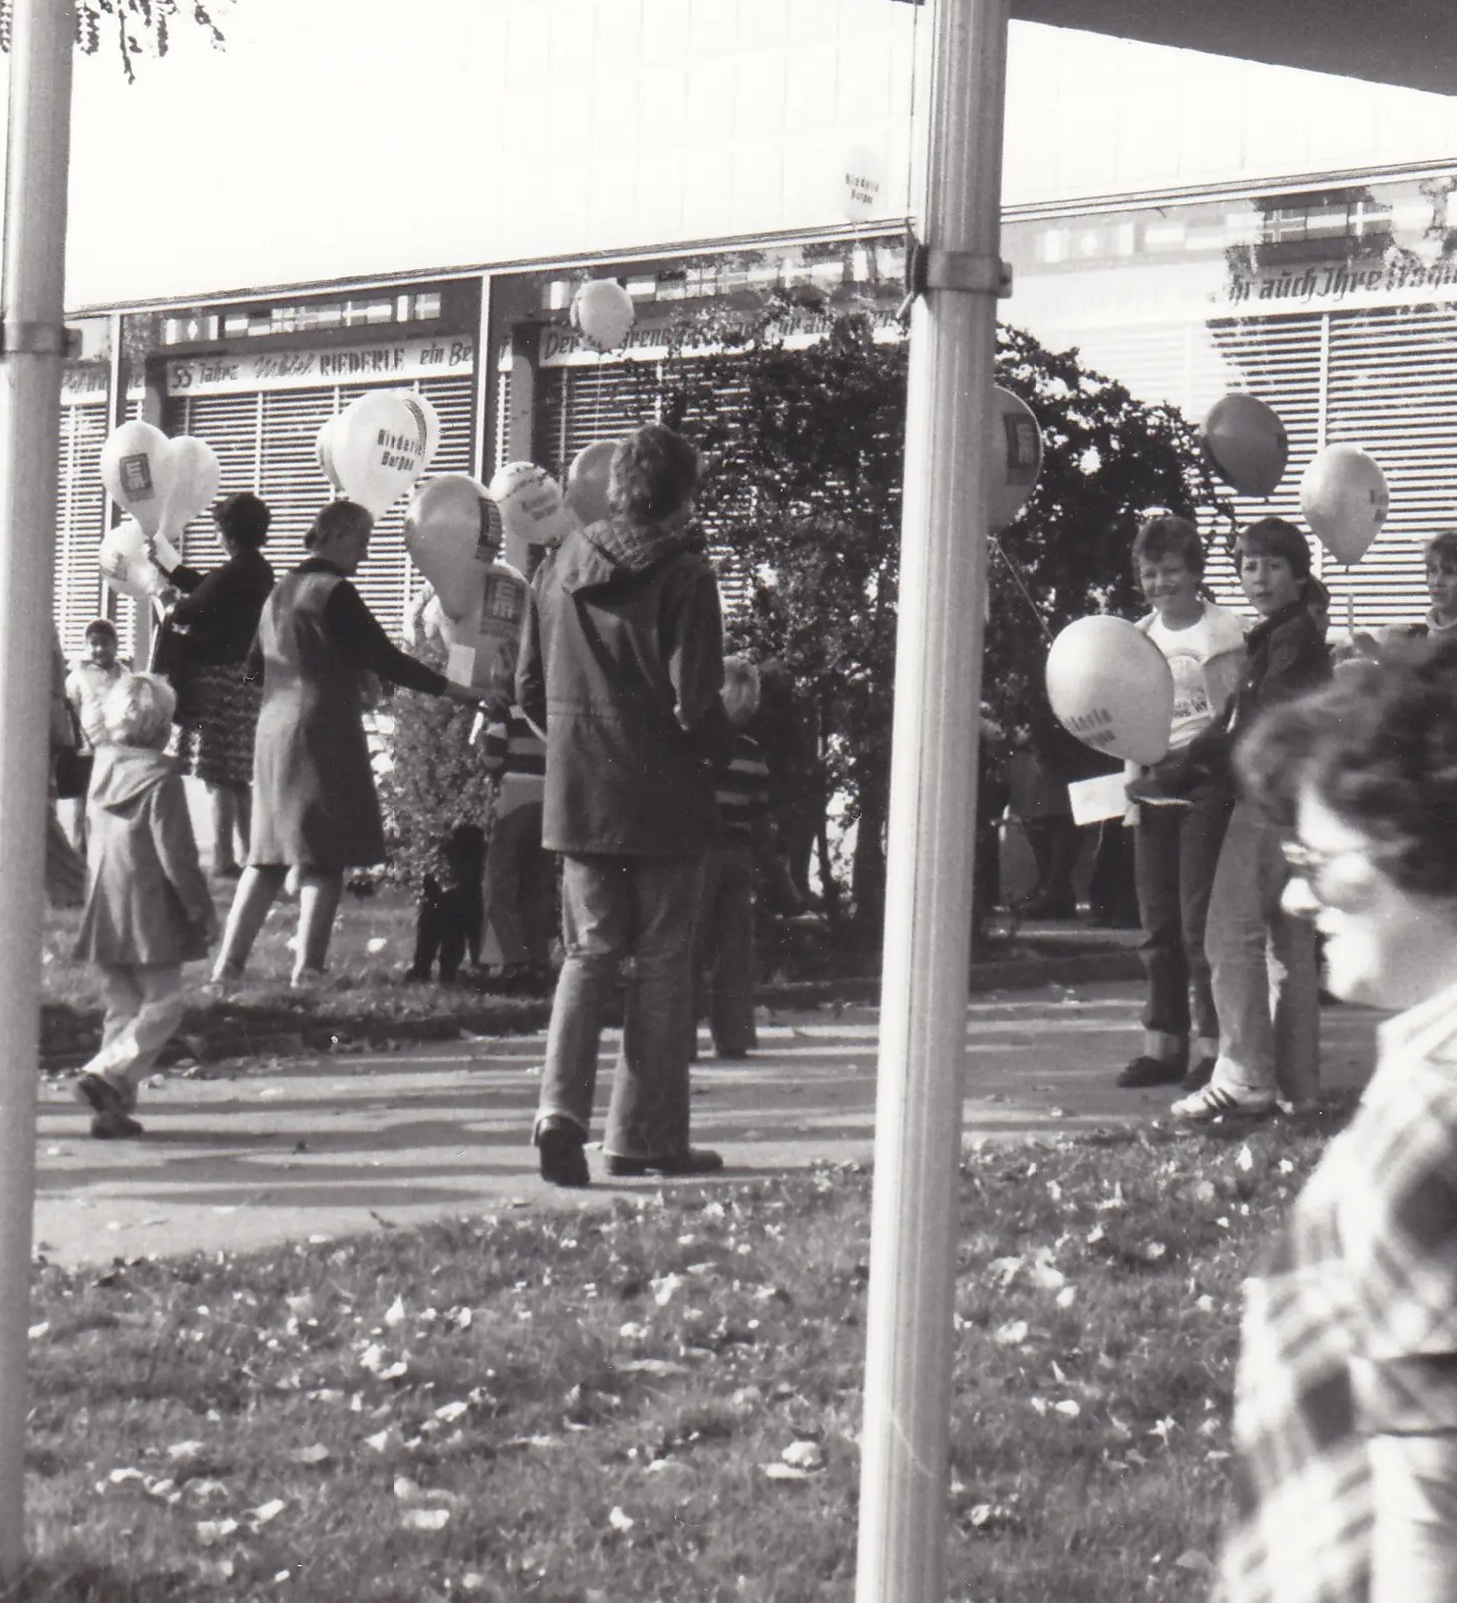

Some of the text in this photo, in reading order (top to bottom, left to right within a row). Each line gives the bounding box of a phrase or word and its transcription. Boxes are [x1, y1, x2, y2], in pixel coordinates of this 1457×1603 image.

[198, 359, 240, 384] Jahre
[320, 346, 407, 377] RIEDERLE
[419, 340, 444, 365] ein
